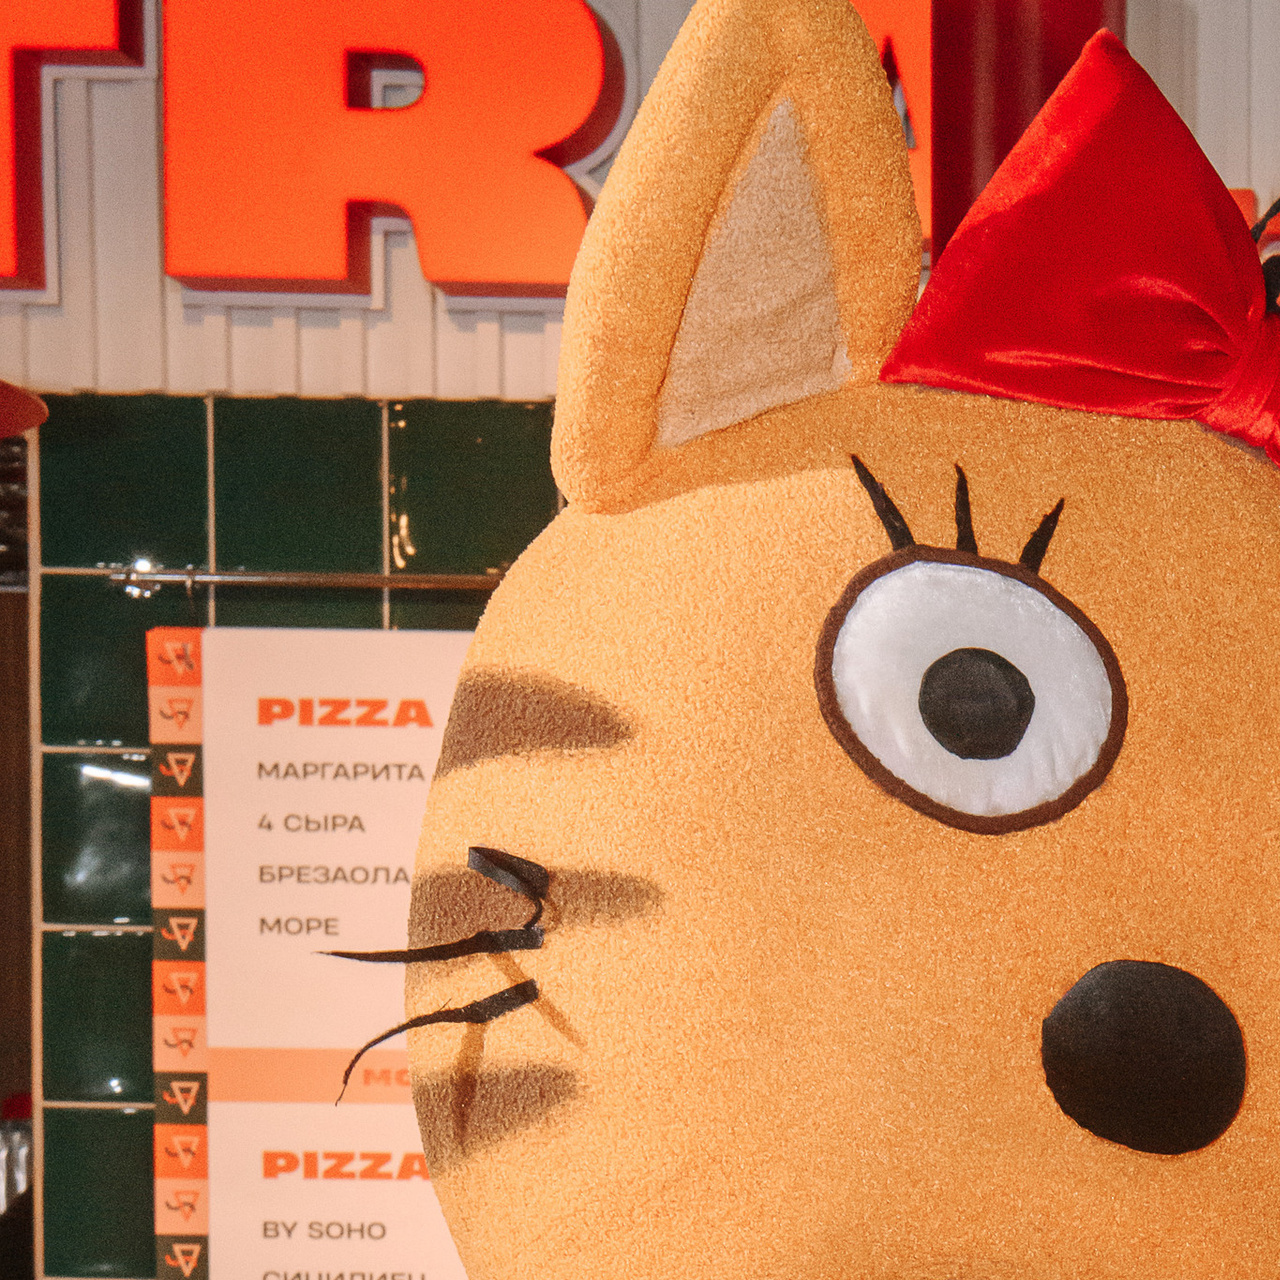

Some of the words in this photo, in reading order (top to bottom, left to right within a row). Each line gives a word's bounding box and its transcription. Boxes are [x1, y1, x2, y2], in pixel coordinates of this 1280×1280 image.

[257, 697, 433, 727] PIZZA
[256, 761, 425, 782] МАРГАРИТА
[257, 814, 274, 832] 4
[282, 813, 366, 833] СЫРА
[258, 865, 410, 885] БРЕЗАОЛА
[259, 916, 339, 936] МОРЕ
[262, 1151, 430, 1180] PIZZA
[262, 1220, 298, 1240] BY
[307, 1220, 387, 1241] SOHO
